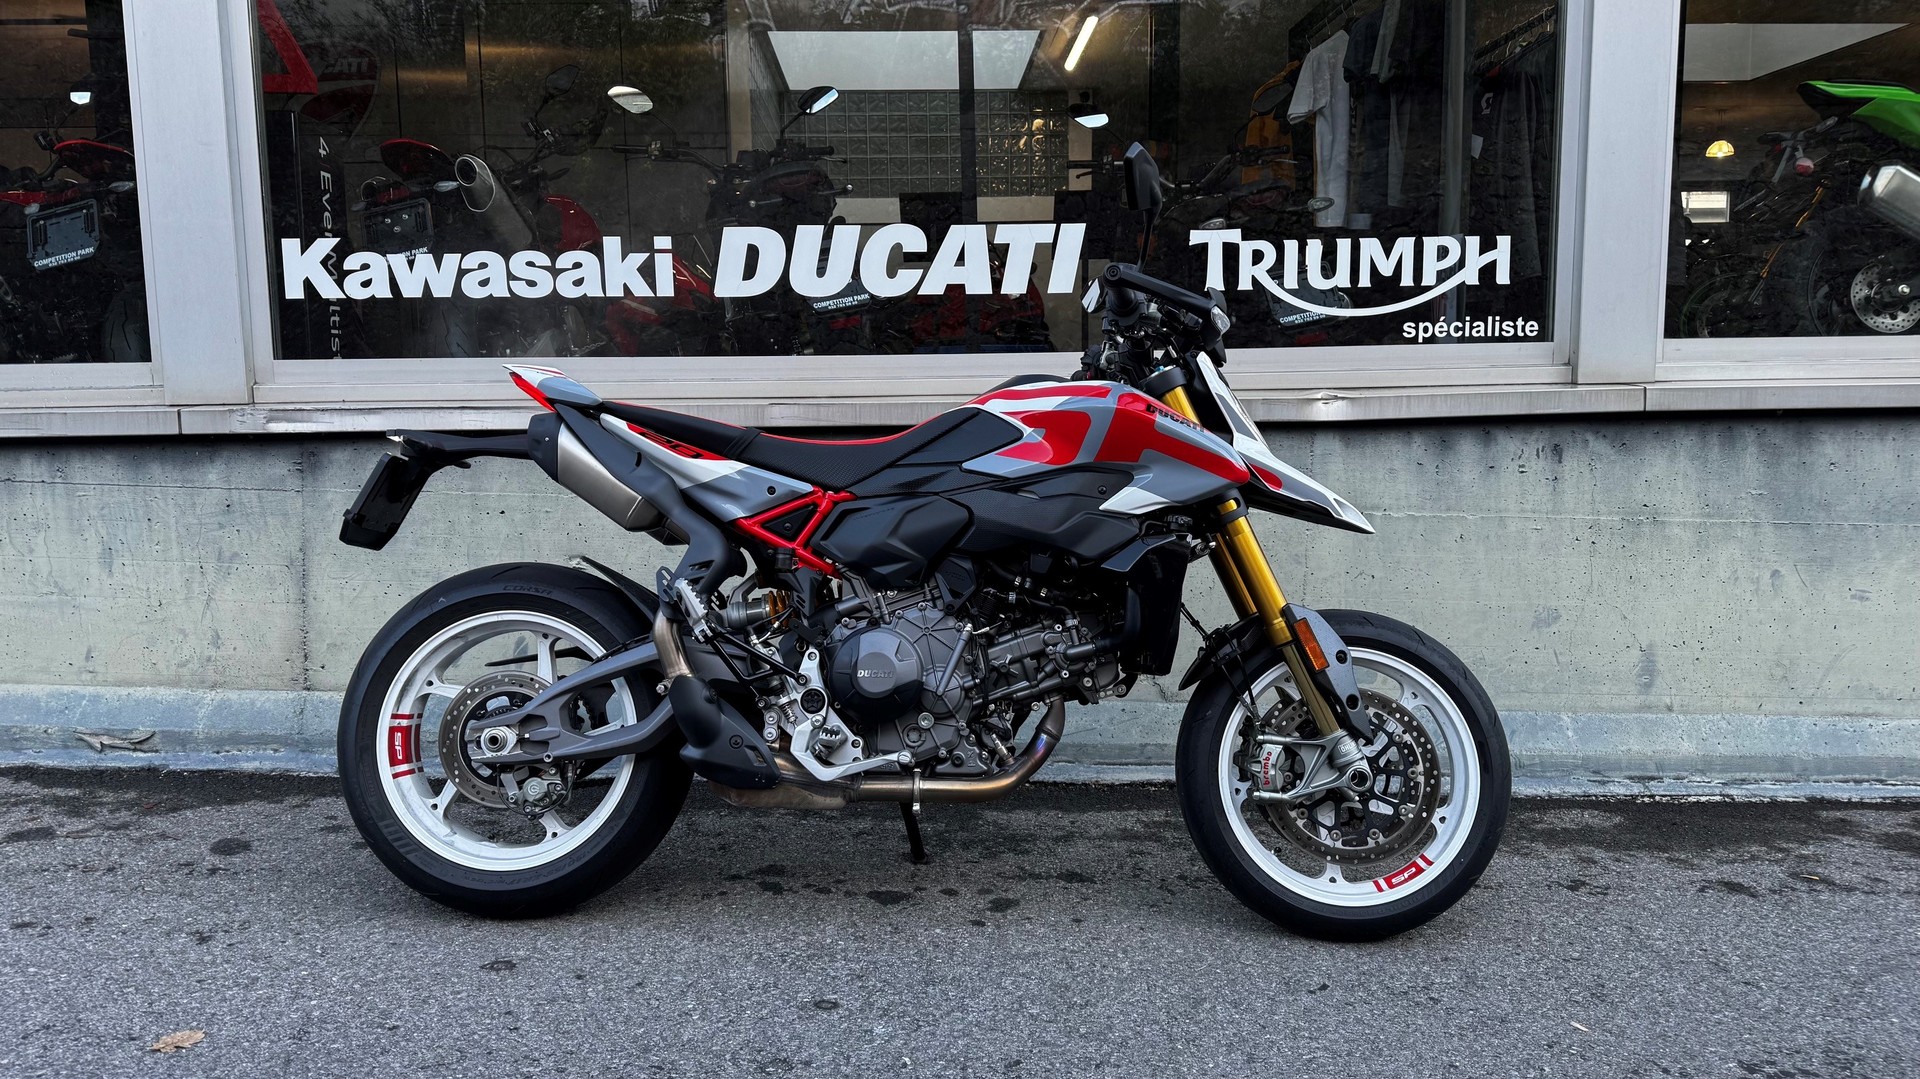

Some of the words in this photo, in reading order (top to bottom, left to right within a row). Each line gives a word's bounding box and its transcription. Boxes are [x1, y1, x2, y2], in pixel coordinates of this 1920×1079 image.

[34, 252, 77, 267] COMPETITION
[77, 247, 94, 257] PARK
[281, 235, 675, 299] Kawasaki
[714, 223, 1086, 298] DUCATI
[1189, 228, 1511, 317] TRIUMPH
[813, 298, 853, 309] COMPETITION
[853, 293, 870, 301] PARK
[1402, 316, 1539, 342] spécialiste
[1146, 404, 1205, 433] DUCATI
[504, 585, 552, 595] CORSA
[857, 669, 893, 679] DUCATI
[394, 731, 403, 760] SP
[1263, 751, 1273, 786] brembo
[1391, 866, 1417, 885] SP
